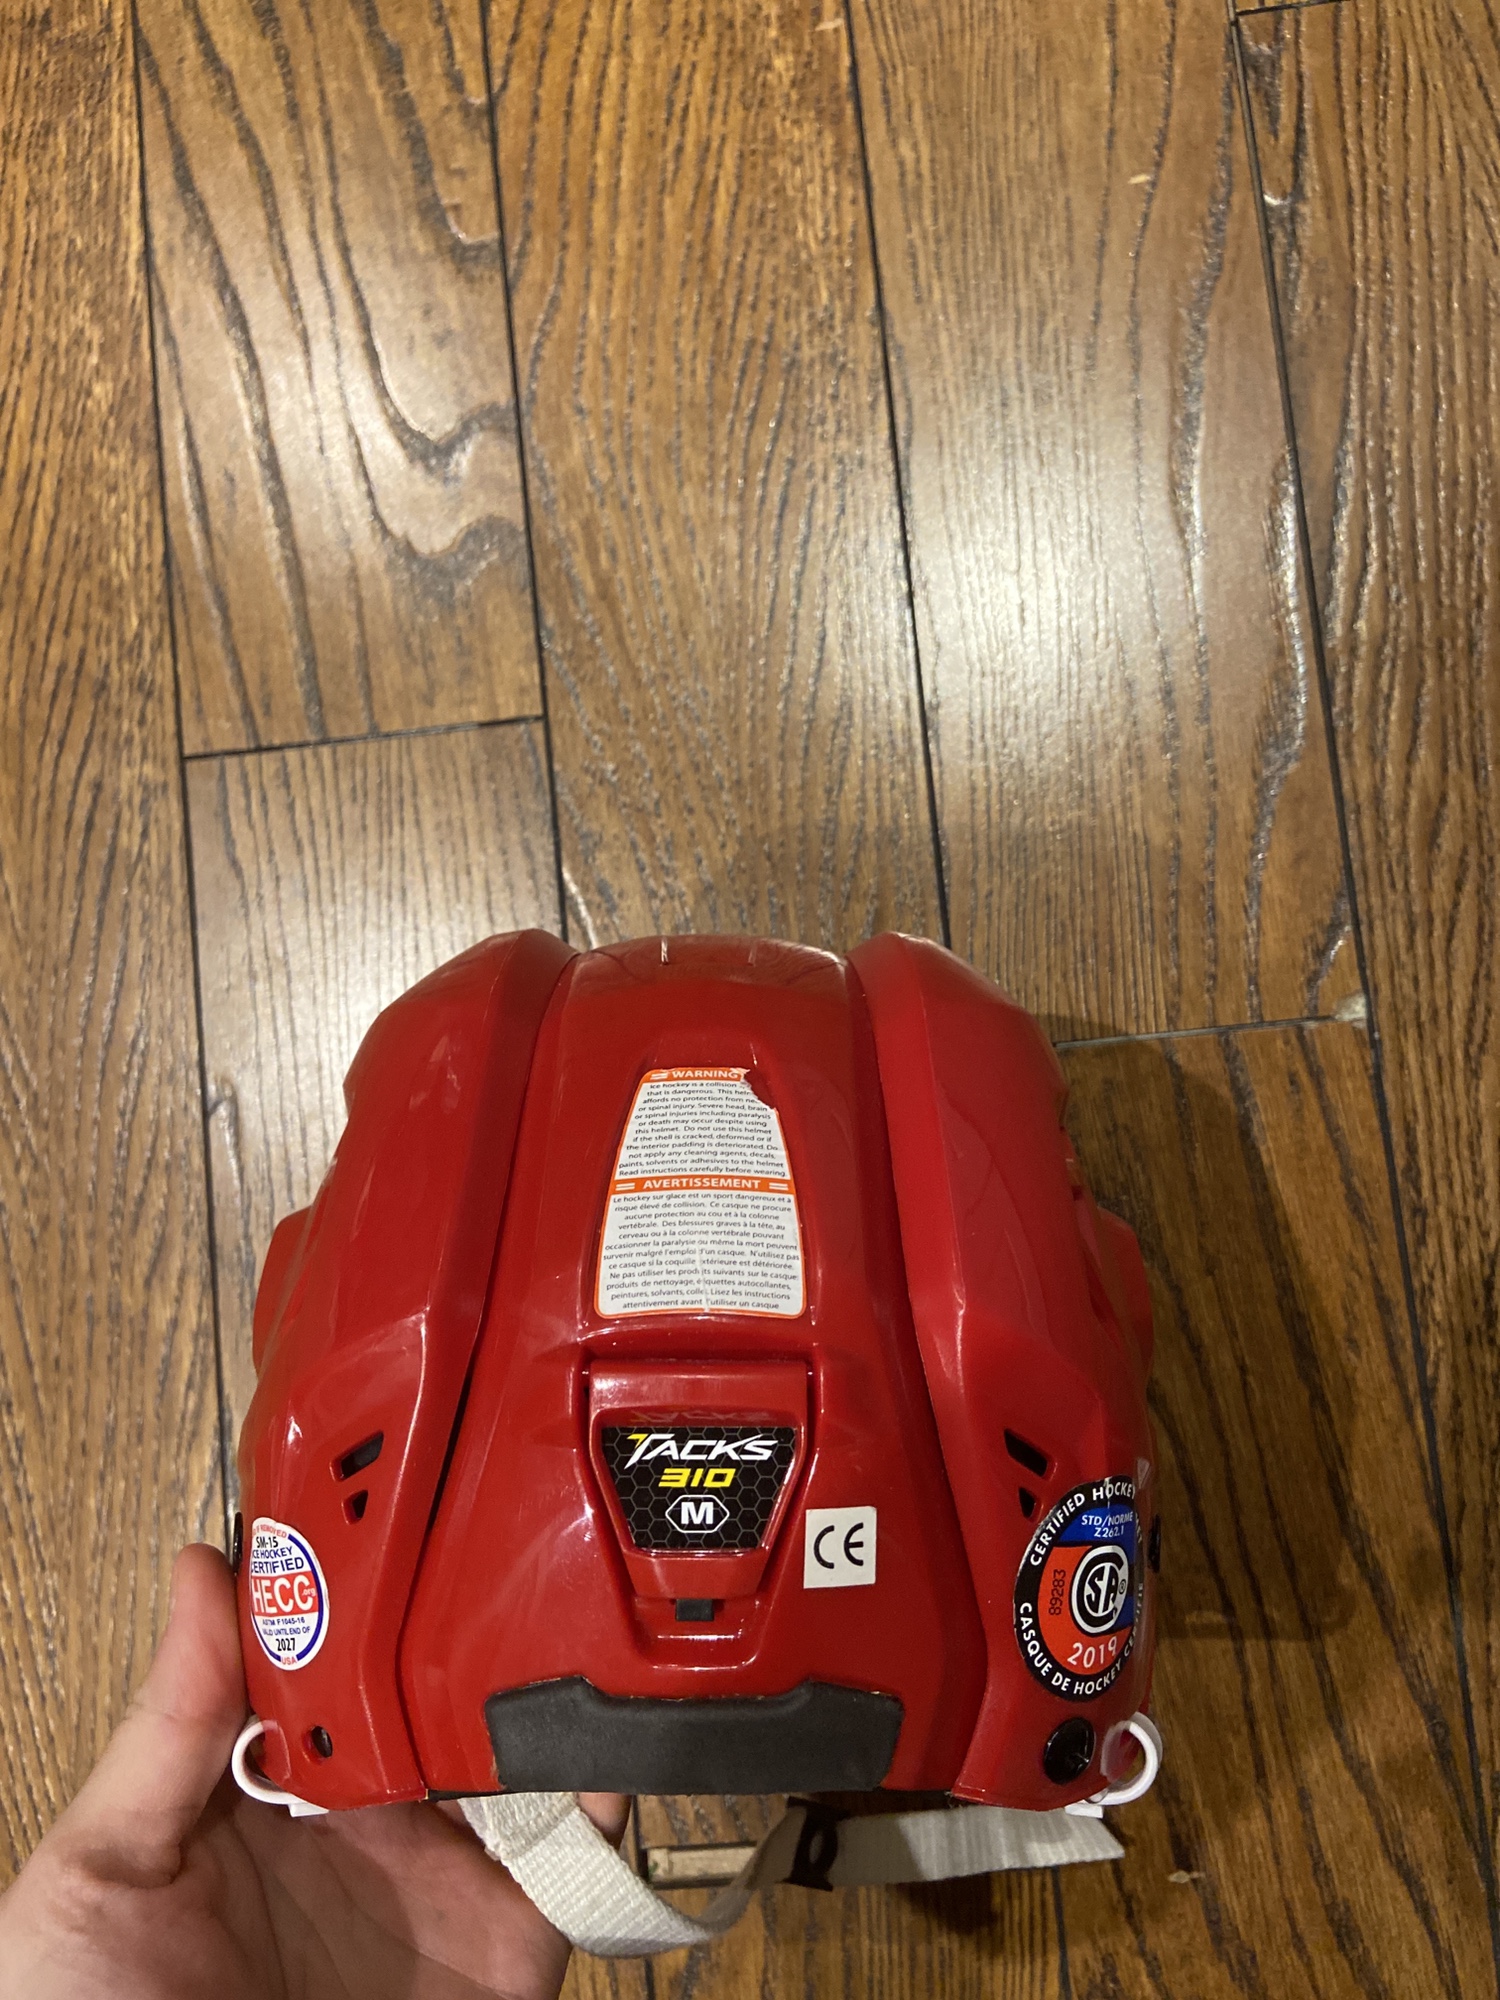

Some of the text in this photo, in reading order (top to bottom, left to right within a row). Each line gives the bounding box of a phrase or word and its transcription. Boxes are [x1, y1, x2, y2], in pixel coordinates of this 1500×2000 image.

[738, 1112, 770, 1120] paralysis
[757, 1160, 784, 1168] helmet
[641, 1167, 687, 1175] instructions
[643, 1179, 761, 1189] AVERTISSEMENT
[735, 1194, 775, 1202] dangereux
[615, 1204, 638, 1212] risque
[752, 1232, 784, 1240] pouvant
[605, 1242, 650, 1250] occasionner
[662, 1238, 695, 1246] paralysie
[604, 1252, 633, 1260] survenir
[665, 1258, 695, 1266] coquille
[607, 1282, 638, 1290] produits
[744, 1290, 790, 1300] instructions
[623, 1300, 678, 1309] attentivement
[624, 1433, 778, 1470] TACKS
[658, 1468, 736, 1488] 310
[681, 1501, 714, 1524] M
[1081, 1512, 1133, 1526] STD/NORME
[1030, 1493, 1085, 1566] CERTIFIED
[1094, 1525, 1124, 1537] Z262.1
[256, 1536, 278, 1548] SM-15
[814, 1522, 864, 1569] CE
[260, 1546, 292, 1559] HOCKEY
[252, 1575, 313, 1614] HECC
[1049, 1569, 1066, 1616] 89283
[302, 1626, 310, 1634] OF
[276, 1638, 296, 1651] 2027
[1020, 1602, 1121, 1695] CASQUE DE HOCKEY
[1067, 1636, 1117, 1669] 2019
[281, 1656, 296, 1665] USA
